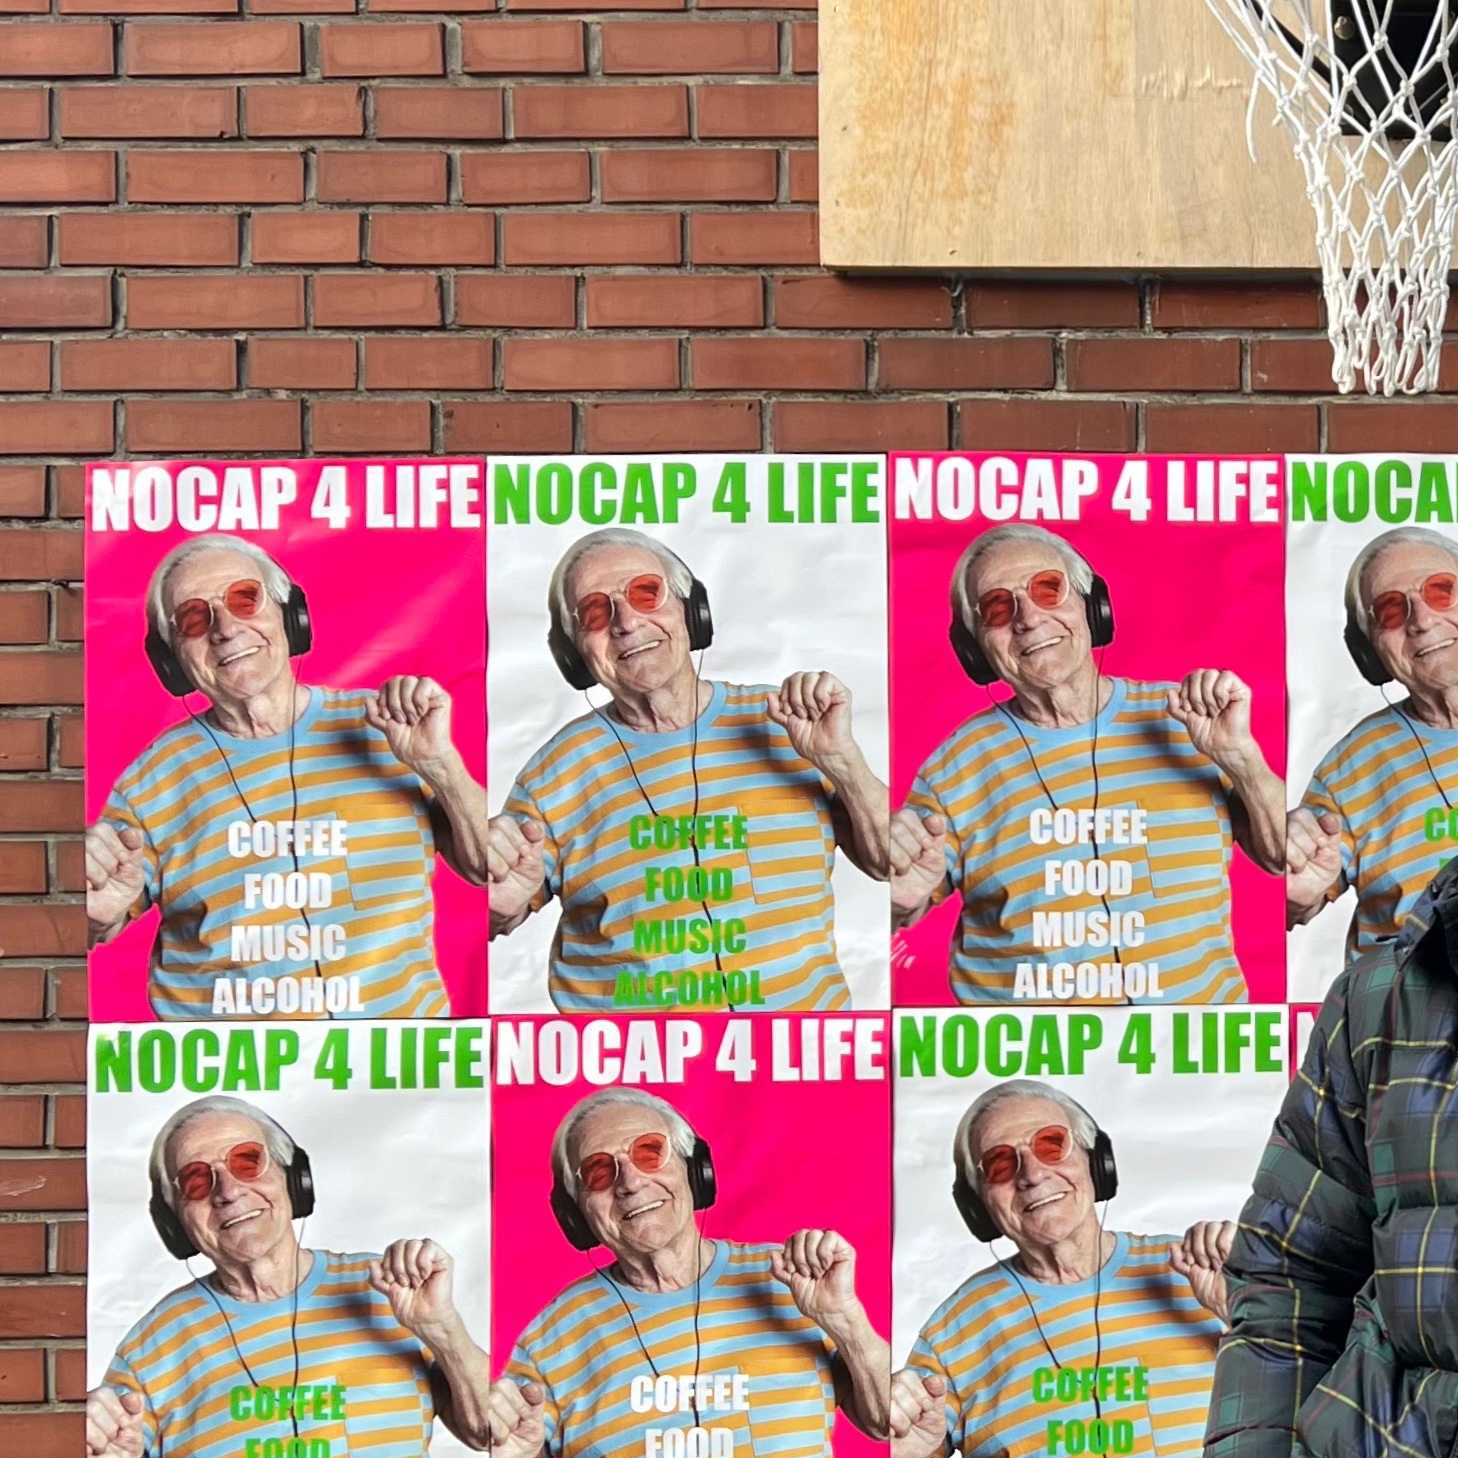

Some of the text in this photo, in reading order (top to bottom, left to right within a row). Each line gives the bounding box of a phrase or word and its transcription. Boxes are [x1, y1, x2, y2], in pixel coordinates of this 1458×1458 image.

[92, 465, 481, 532] NOCAP 4 LIFE
[494, 462, 880, 525] NOCAP 4 LIFE
[895, 458, 1279, 522] NOCAP 4 LIFE
[228, 820, 347, 857] COFFEE
[629, 815, 748, 851] COFFEE
[1029, 808, 1148, 844] COFFEE
[244, 872, 332, 909] FOOD
[645, 866, 733, 903] FOOD
[1044, 860, 1132, 897] FOOD
[230, 924, 347, 962] MUSIC
[632, 918, 746, 955] MUSIC
[1032, 911, 1145, 947] MUSIC
[211, 976, 365, 1015] ALCOHOL
[613, 970, 765, 1006] ALCOHOL
[1013, 961, 1163, 999] ALCOHOL
[95, 1028, 484, 1094] NOCAP 4 LIFE
[497, 1018, 884, 1086] NOCAP 4 LIFE
[899, 1015, 1103, 1078] NOCAP
[1118, 1013, 1157, 1075] 4
[1172, 1012, 1283, 1073] LIFE
[630, 1374, 750, 1412] COFFEE
[1032, 1366, 1149, 1402] COFFEE
[229, 1385, 346, 1421] COFFEE
[1047, 1418, 1133, 1455] FOOD
